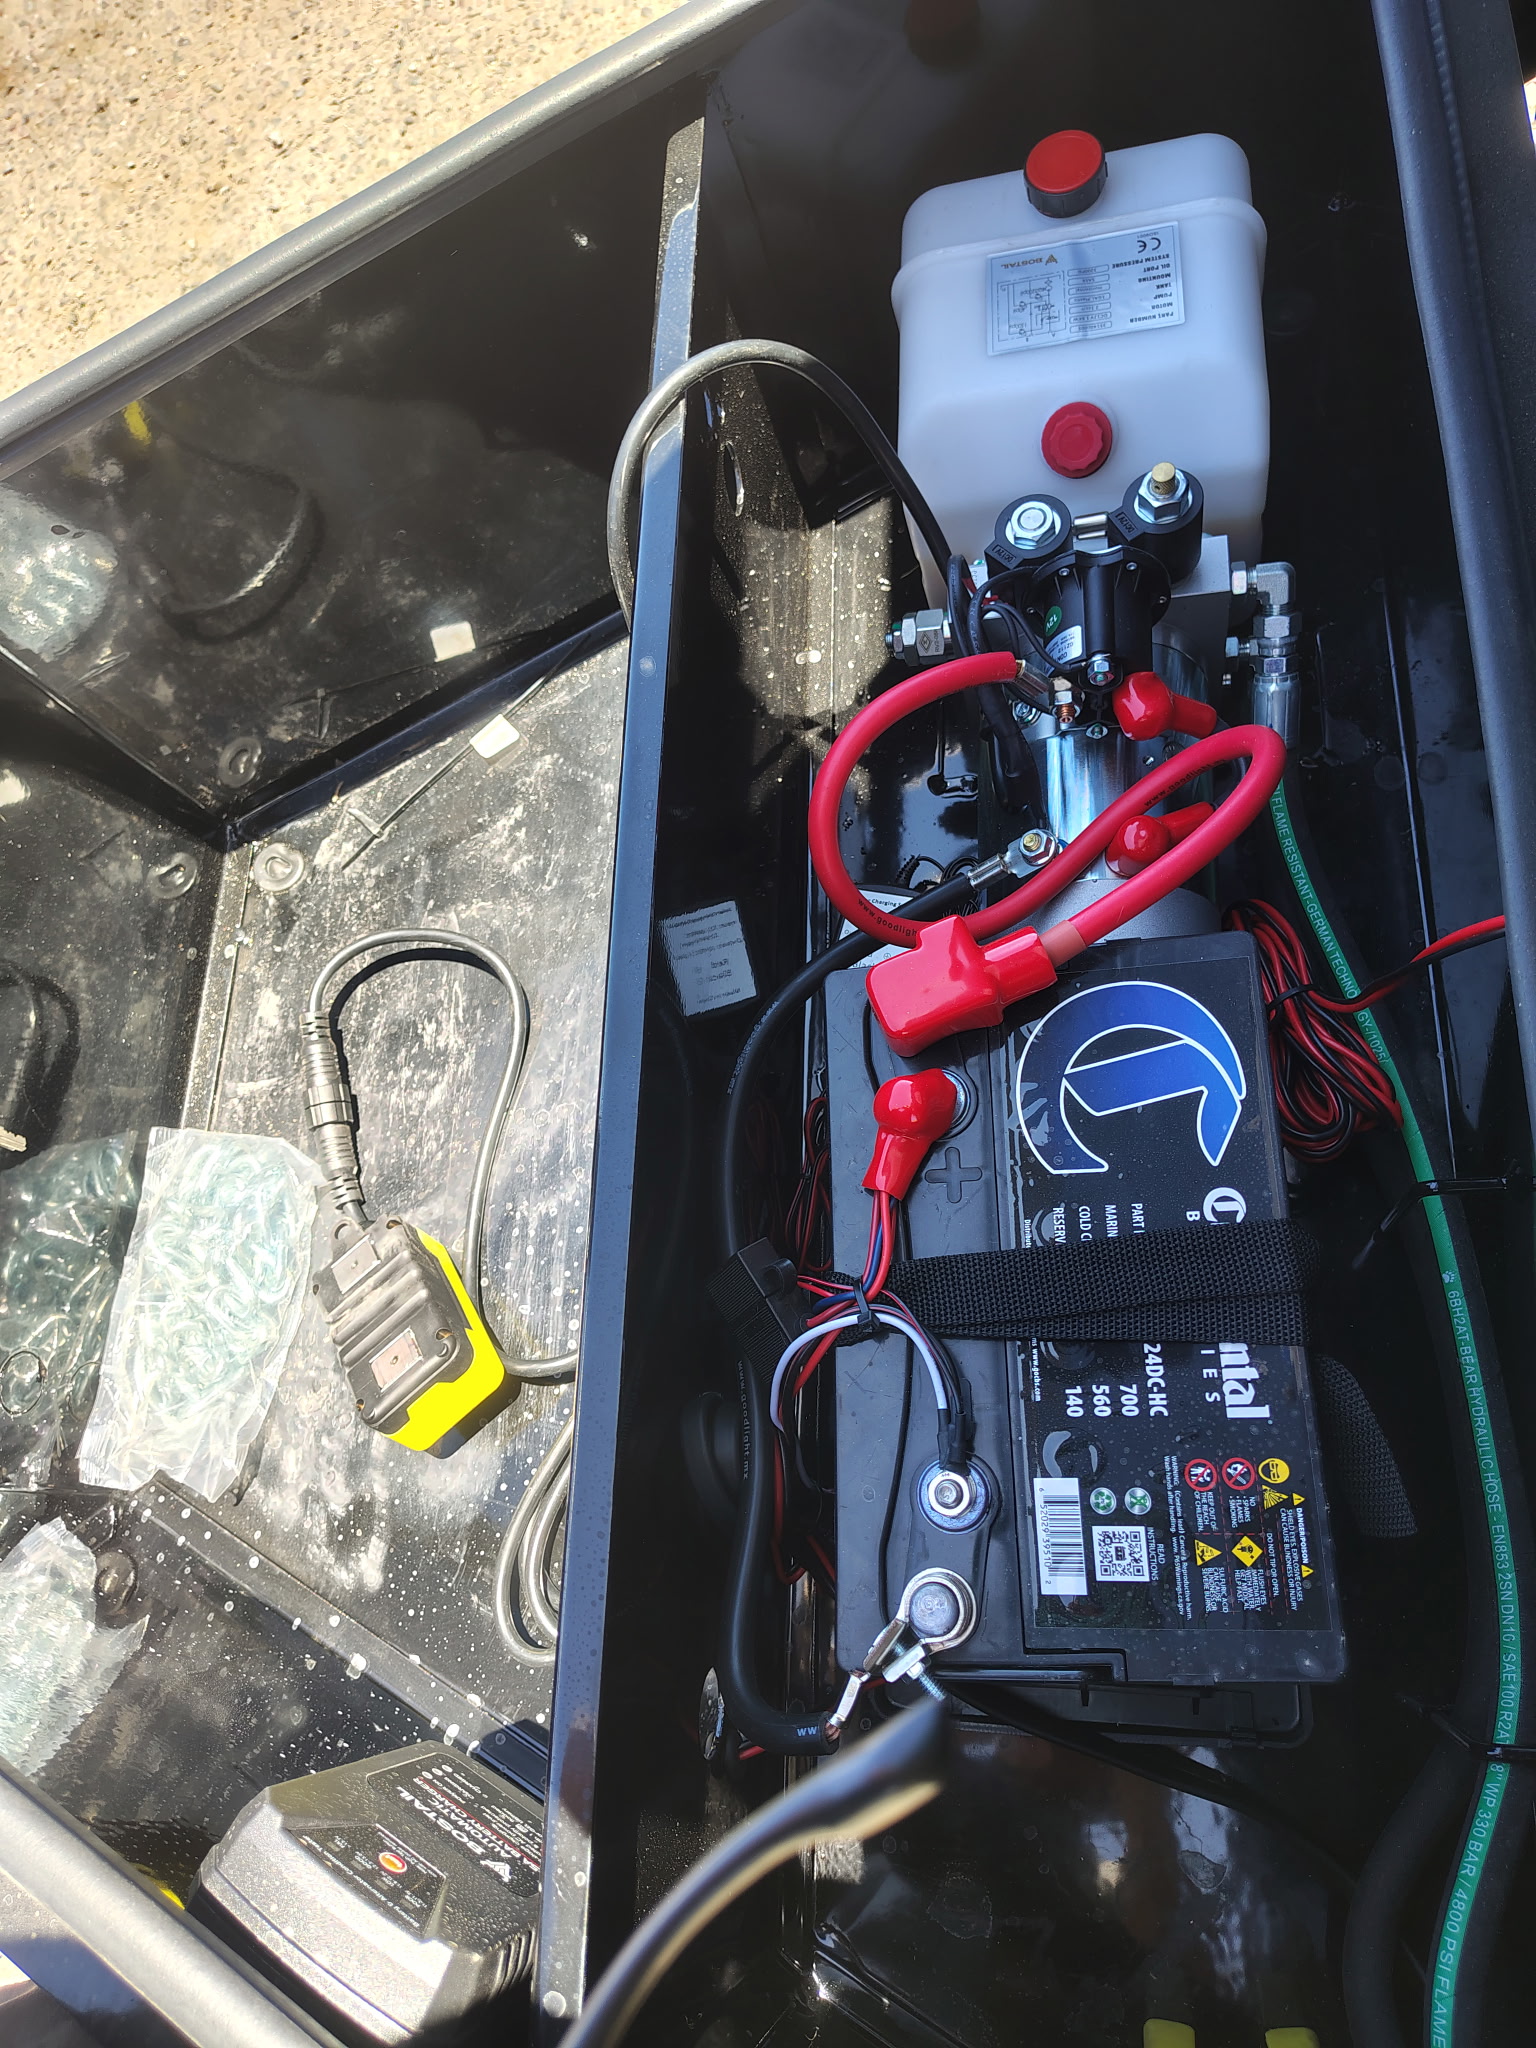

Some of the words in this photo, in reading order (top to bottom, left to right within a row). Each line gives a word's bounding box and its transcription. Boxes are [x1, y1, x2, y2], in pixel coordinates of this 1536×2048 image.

[1000, 257, 1042, 269] BOSTAIL
[1111, 258, 1143, 268] PRESSURE
[1144, 253, 1169, 262] SYSTEM
[1137, 272, 1170, 282] MOUNTING
[1151, 301, 1172, 309] MOTOR
[1153, 291, 1172, 299] PUMP
[1129, 314, 1156, 323] NUMBER
[1046, 612, 1057, 628] 12V
[1272, 798, 1290, 837] FLAME
[1282, 838, 1334, 952] RESISTANT-GERMAN
[872, 898, 897, 907] Charging
[858, 898, 917, 936] www.goodligh
[1052, 1207, 1066, 1244] RESERV
[1078, 1206, 1091, 1230] COLD
[1104, 1204, 1118, 1237] MARIN
[1131, 1203, 1144, 1227] PART
[1448, 1291, 1478, 1384] 6BH2AT-BEAR
[1030, 1348, 1041, 1401] www.gocbs.com
[1143, 1342, 1167, 1417] 24DC-HC
[1064, 1385, 1083, 1417] 140
[1091, 1384, 1110, 1417] 560
[1119, 1384, 1138, 1416] 700
[737, 1360, 750, 1479] www.goodlight.mx
[1468, 1388, 1494, 1469] HYDRAULIC
[1194, 1490, 1200, 1499] OF
[1249, 1496, 1255, 1506] NO
[1484, 1473, 1502, 1512] HOSE
[1039, 1504, 1048, 1532] 52029
[1229, 1499, 1237, 1527] SMOKING
[1242, 1499, 1250, 1521] SPARKS
[1170, 1455, 1178, 1485] WARNING:
[1181, 1562, 1190, 1601] Reproductive
[1210, 1521, 1216, 1529] OF
[1266, 1532, 1272, 1541] DO
[1281, 1522, 1289, 1542] CAUSE
[1296, 1507, 1307, 1563] DANGER/POISON
[1042, 1537, 1051, 1567] 39510
[1147, 1526, 1157, 1580] INSTRUCTIONS
[1284, 1543, 1293, 1577] BLINDNESS
[1492, 1524, 1509, 1570] EN853
[1270, 1567, 1276, 1575] OR
[1291, 1548, 1300, 1581] EXPLOSIVE
[1218, 1567, 1226, 1595] SULFURIC
[1241, 1581, 1249, 1609] MEDICAL
[1251, 1569, 1261, 1611] IMMEDIATELY
[1271, 1576, 1279, 1596] OPEN.
[1288, 1578, 1294, 1587] OR
[1498, 1572, 1513, 1600] 2SN
[1289, 1588, 1297, 1610] INJURY
[1502, 1652, 1516, 1682] SAE
[1501, 1684, 1515, 1707] 100
[796, 1726, 816, 1736] ww
[432, 1778, 442, 1787] ON
[442, 1785, 466, 1804] POWER
[1482, 1784, 1501, 1808] WP
[412, 1775, 469, 1820] CHARGER
[393, 1784, 487, 1856] BOSTAIL
[426, 1794, 512, 1860] AUTOMATIC
[1473, 1810, 1492, 1838] 330
[301, 1833, 323, 1851] Tester
[467, 1816, 519, 1857] BATTERY
[322, 1848, 353, 1875] Condition
[1460, 1840, 1484, 1877] BAR
[351, 1872, 387, 1902] Alternator
[392, 1903, 420, 1928] Battery
[1446, 1892, 1468, 1932] 4800
[1438, 1936, 1456, 1970] PSI
[1433, 1974, 1449, 2048] FLAME
